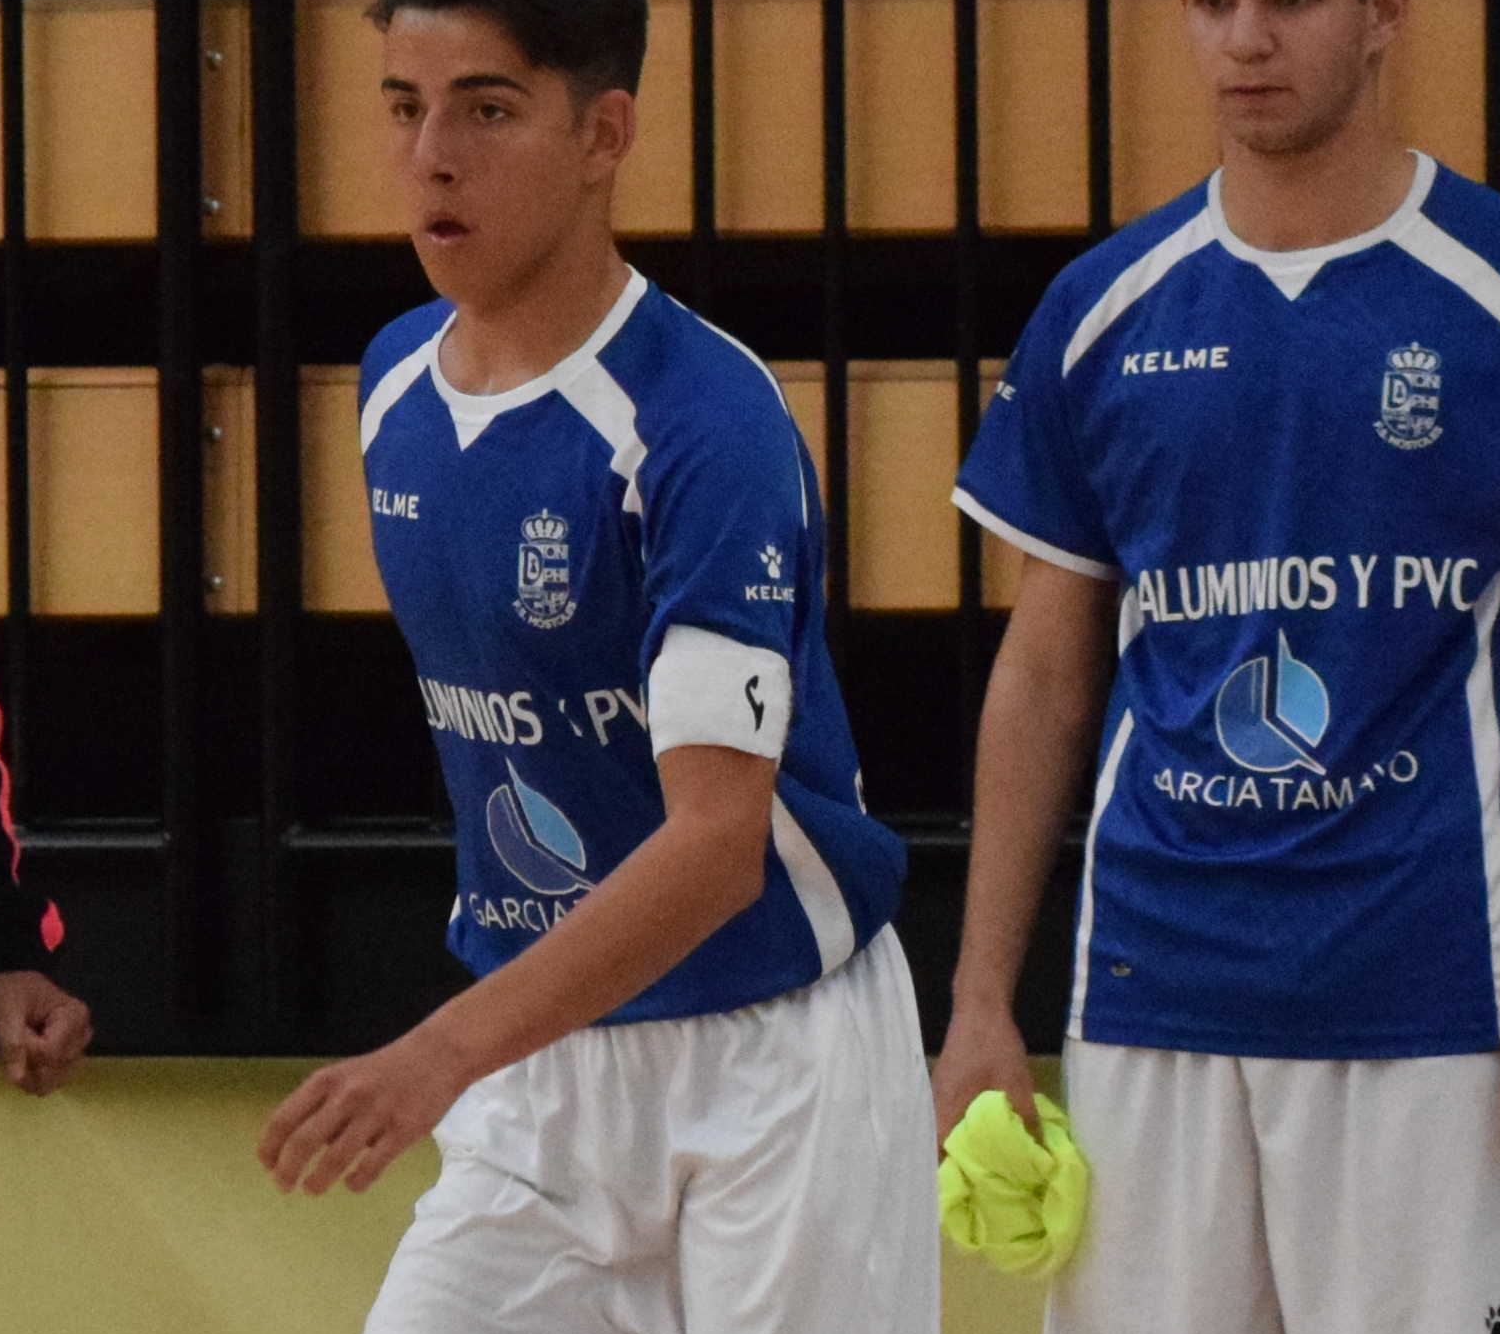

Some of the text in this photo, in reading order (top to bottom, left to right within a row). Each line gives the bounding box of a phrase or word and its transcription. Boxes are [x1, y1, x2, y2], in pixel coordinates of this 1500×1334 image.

[1122, 346, 1230, 376] KELME
[1137, 554, 1479, 623] ALUMINIOS Y PVC
